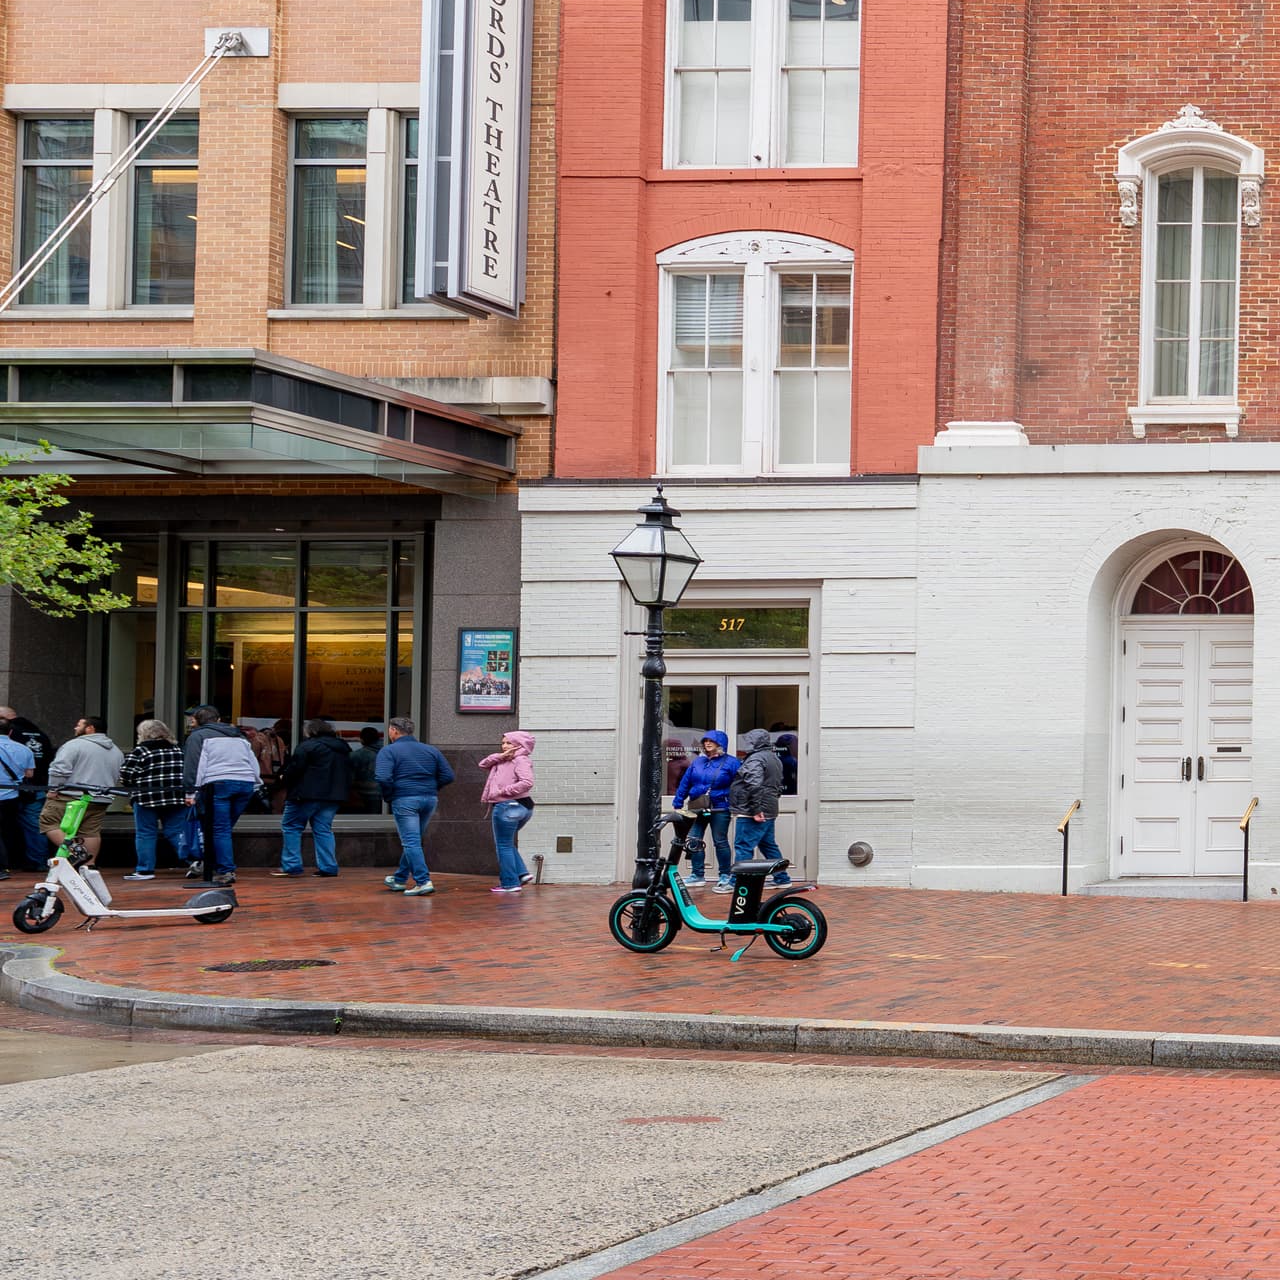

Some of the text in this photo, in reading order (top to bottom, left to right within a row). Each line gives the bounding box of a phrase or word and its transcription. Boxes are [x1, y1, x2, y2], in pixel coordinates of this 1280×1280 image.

[482, 96, 504, 280] THEATRE
[719, 618, 745, 631] 517
[734, 886, 749, 915] veo
